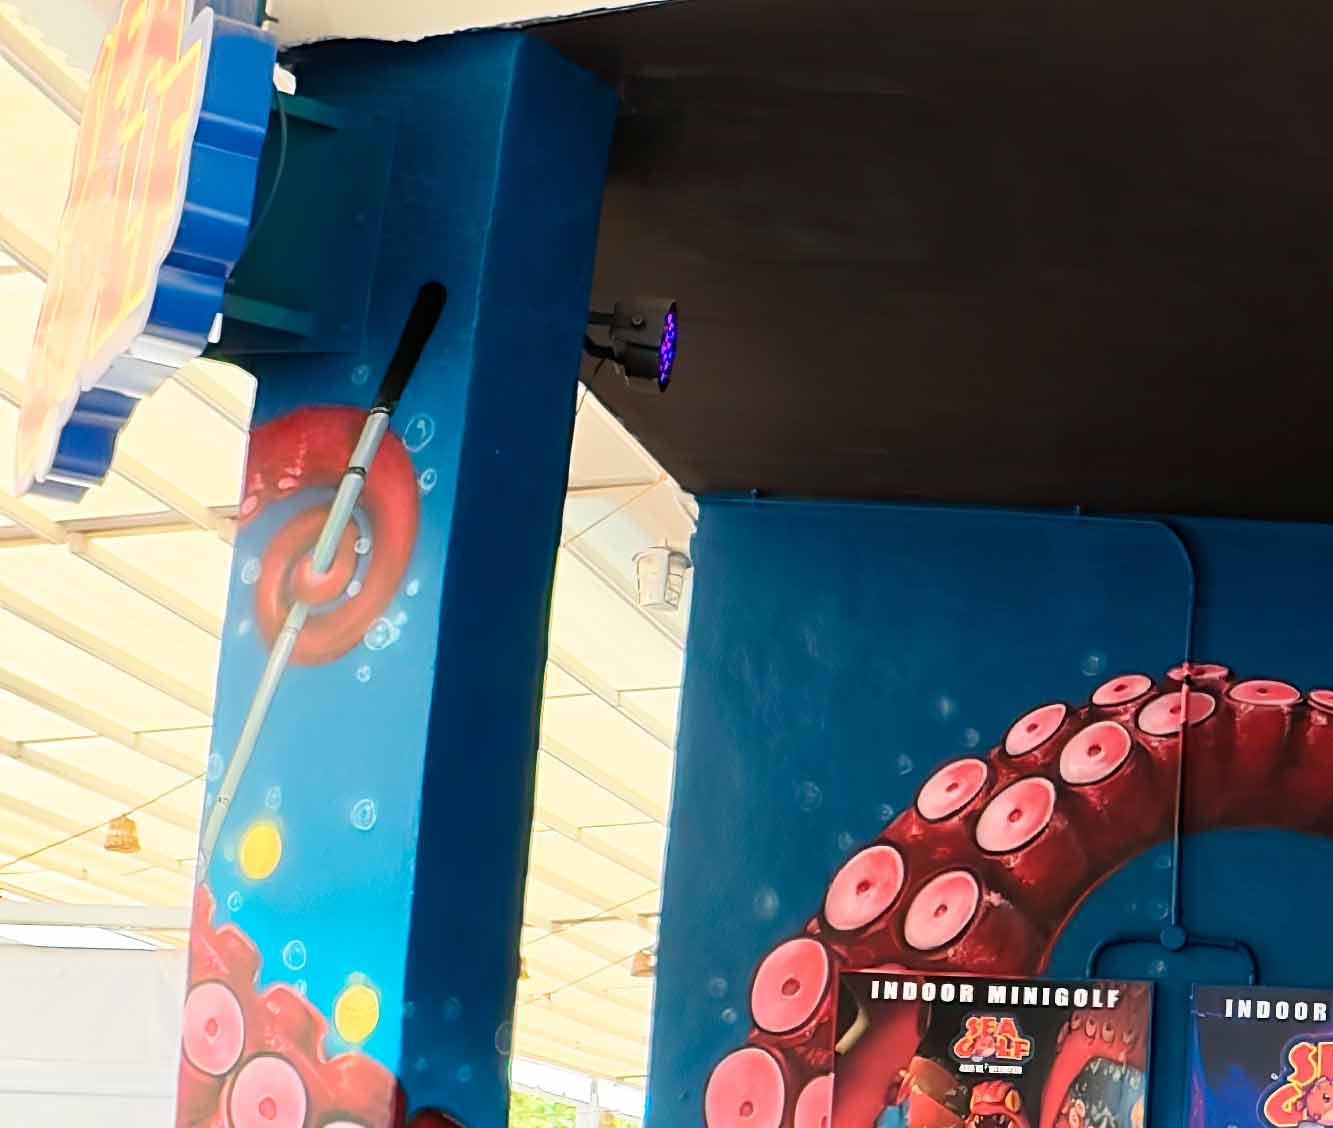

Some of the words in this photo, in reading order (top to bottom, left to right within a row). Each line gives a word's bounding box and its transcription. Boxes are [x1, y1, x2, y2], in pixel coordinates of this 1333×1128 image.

[871, 980, 974, 1003] INDOOR
[988, 985, 1120, 1008] MINIGOLF
[1225, 999, 1327, 1021] INDOOR
[966, 1016, 1018, 1038] SEA
[953, 1034, 1031, 1060] GLF
